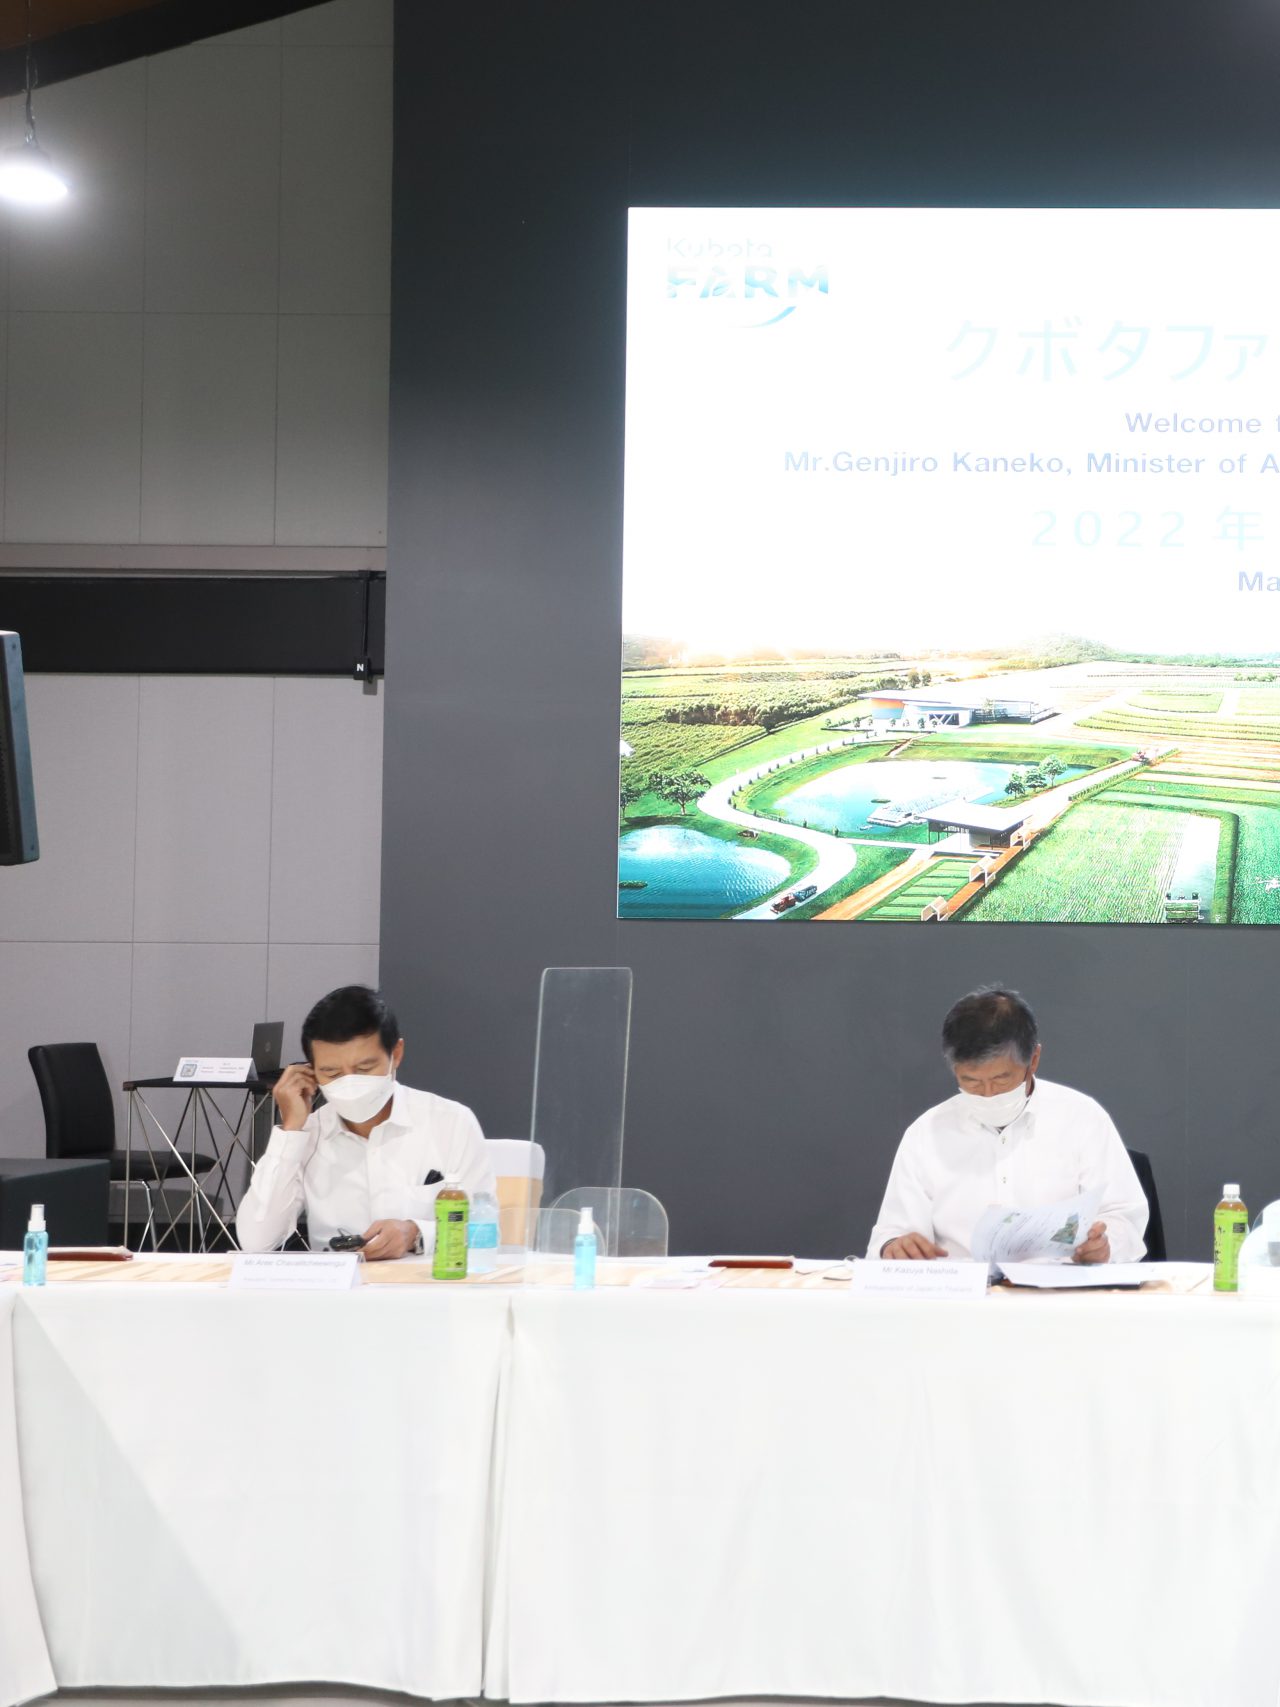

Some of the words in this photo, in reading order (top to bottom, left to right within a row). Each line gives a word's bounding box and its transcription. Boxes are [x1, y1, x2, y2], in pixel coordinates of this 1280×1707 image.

[667, 237, 773, 258] Kubota
[666, 264, 831, 299] FARM
[1123, 413, 1264, 434] Welcome
[785, 452, 938, 477] Mr.Genjiro
[952, 452, 1072, 476] Kaneko,
[1087, 452, 1206, 474] Minister
[1219, 453, 1248, 474] of
